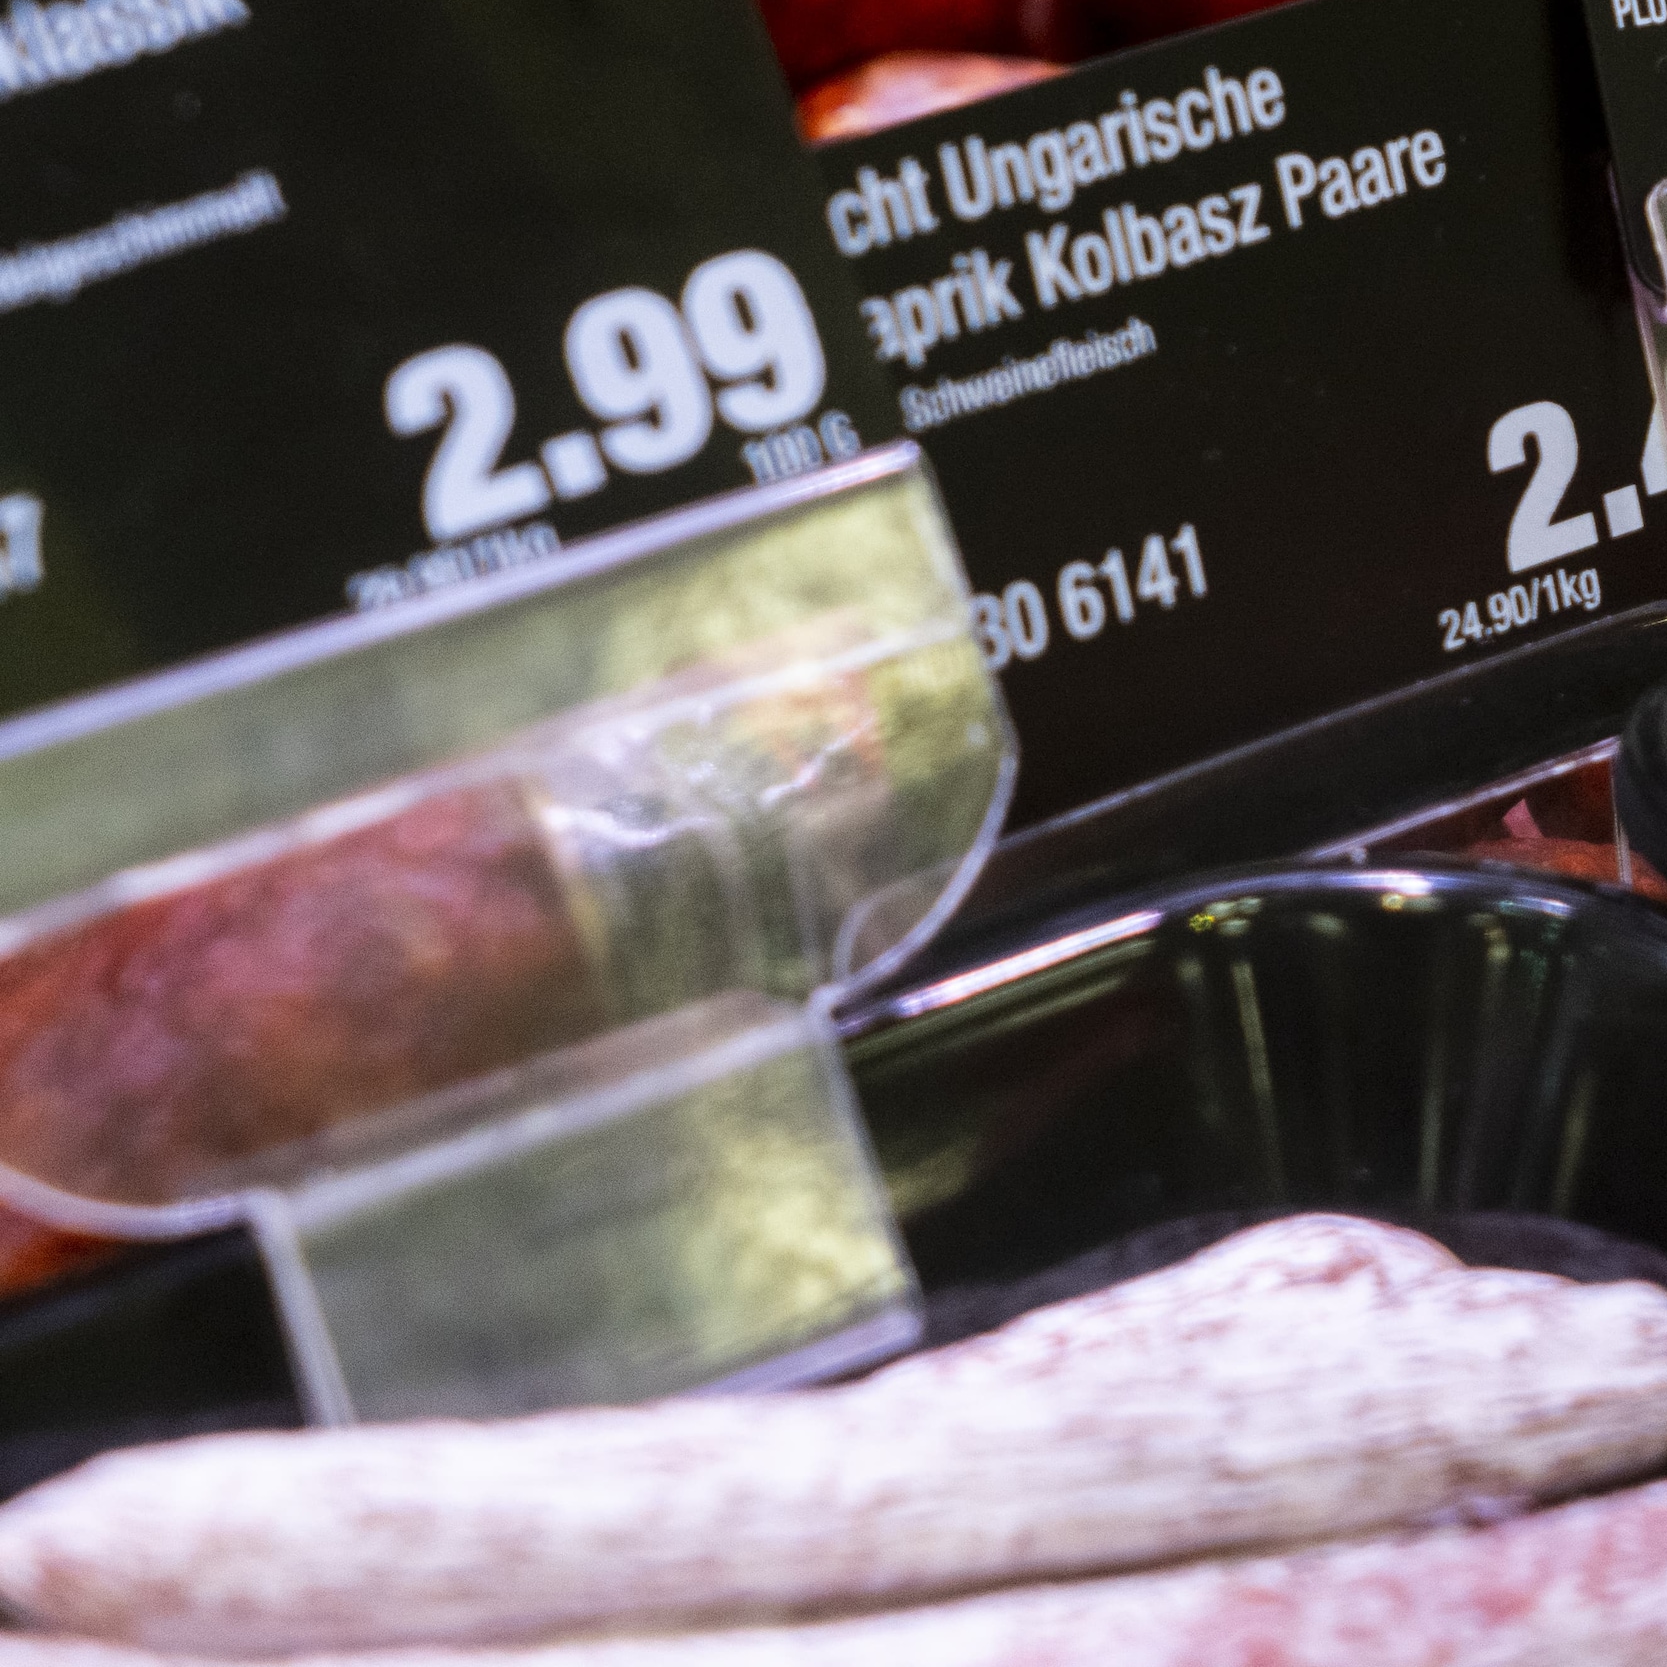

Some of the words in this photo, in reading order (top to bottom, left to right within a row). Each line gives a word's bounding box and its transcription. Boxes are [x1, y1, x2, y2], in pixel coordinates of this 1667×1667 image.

[825, 157, 939, 256] cht
[938, 65, 1287, 222] Ungarische
[861, 249, 1024, 369] aprik
[1025, 183, 1271, 310] Kolbasz
[1274, 129, 1447, 230] Paare
[385, 249, 827, 540] 2.99
[901, 316, 1158, 431] Schweinefleisch
[1057, 522, 1208, 641] 6141
[1438, 568, 1602, 652] 24.90/1kg
